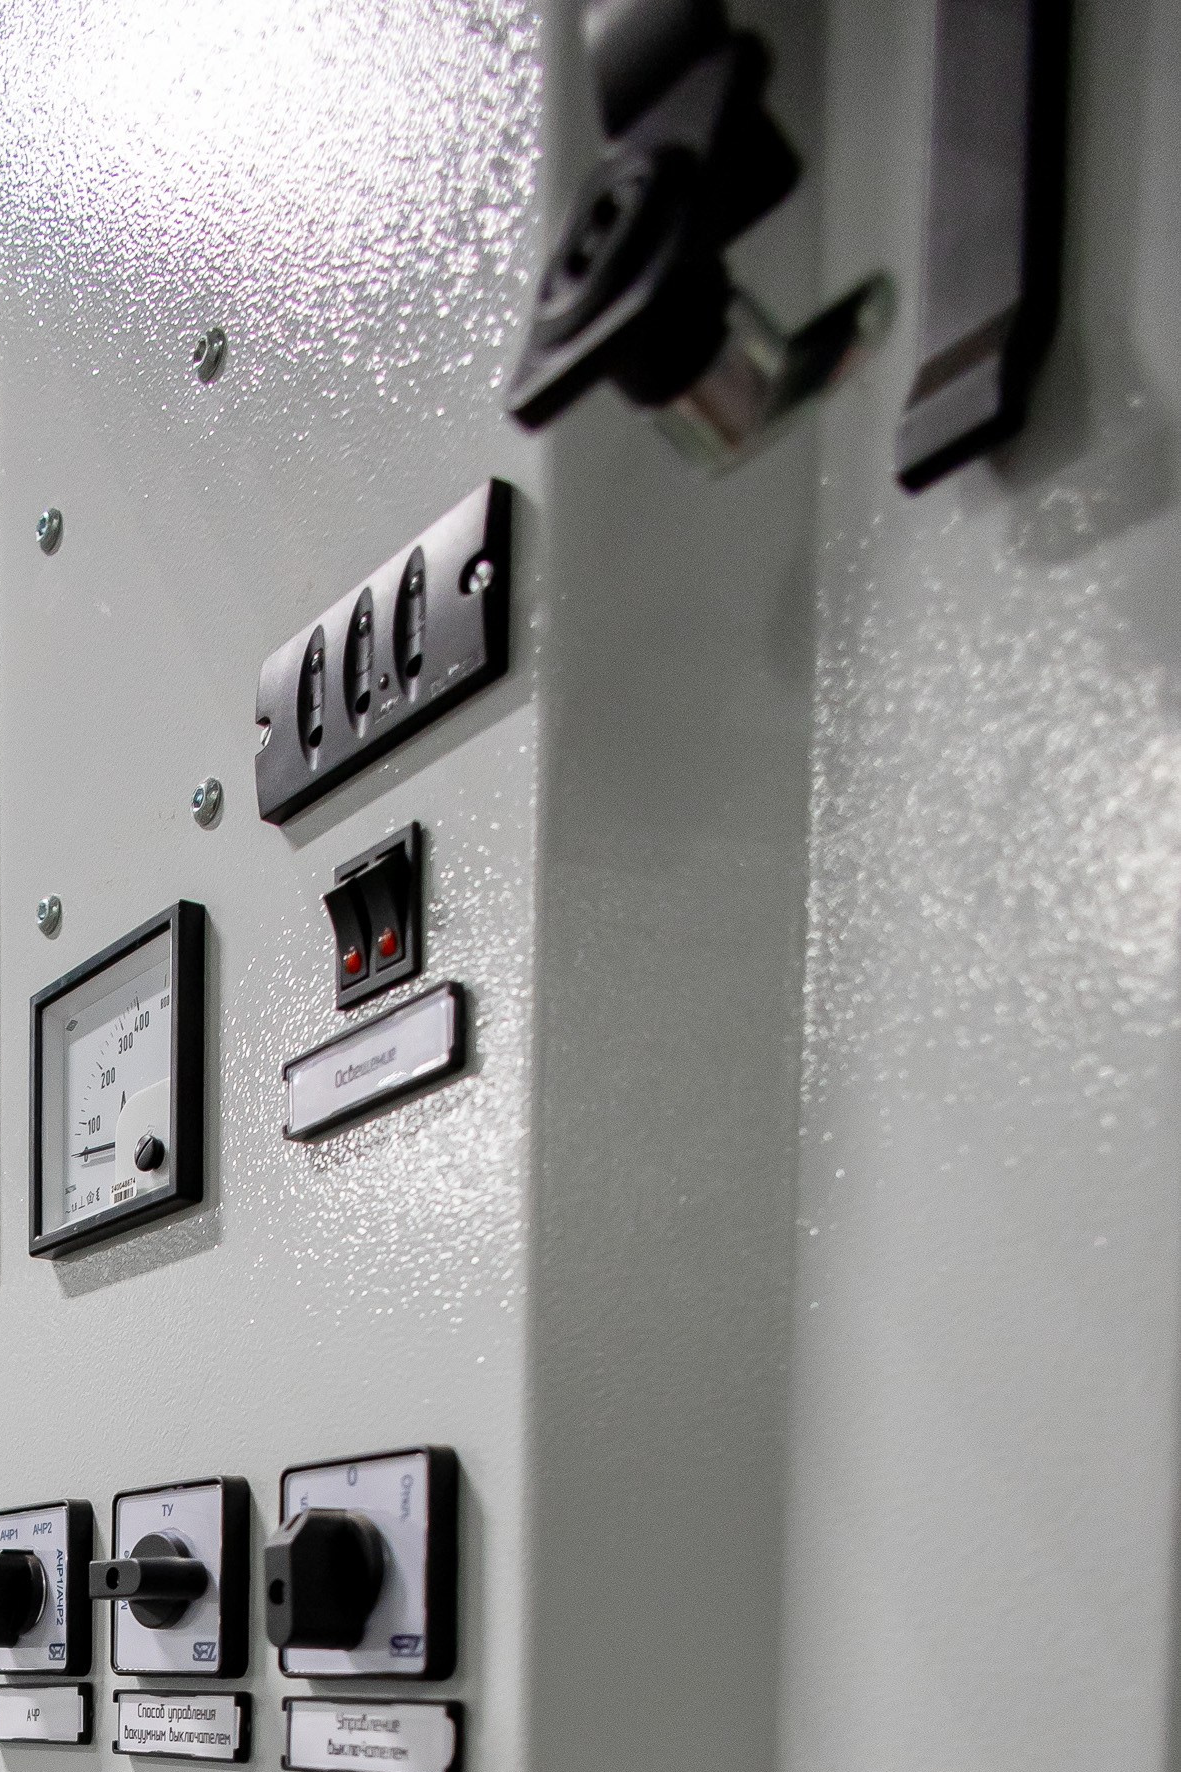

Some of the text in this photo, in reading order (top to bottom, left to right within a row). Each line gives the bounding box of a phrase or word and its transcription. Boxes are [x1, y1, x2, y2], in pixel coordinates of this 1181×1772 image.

[134, 1010, 150, 1033] 400
[118, 1031, 134, 1055] 300
[100, 1066, 116, 1089] 200
[87, 1115, 101, 1135] 100
[161, 1503, 174, 1517] ТУ
[0, 1528, 18, 1542] АЧР1
[32, 1521, 53, 1536] АЧР2
[56, 1549, 65, 1626] АЧР1/АЧР2
[26, 1708, 41, 1722] АЧР
[137, 1702, 217, 1723] Способ управления
[123, 1724, 232, 1746] вакуумным выключателем
